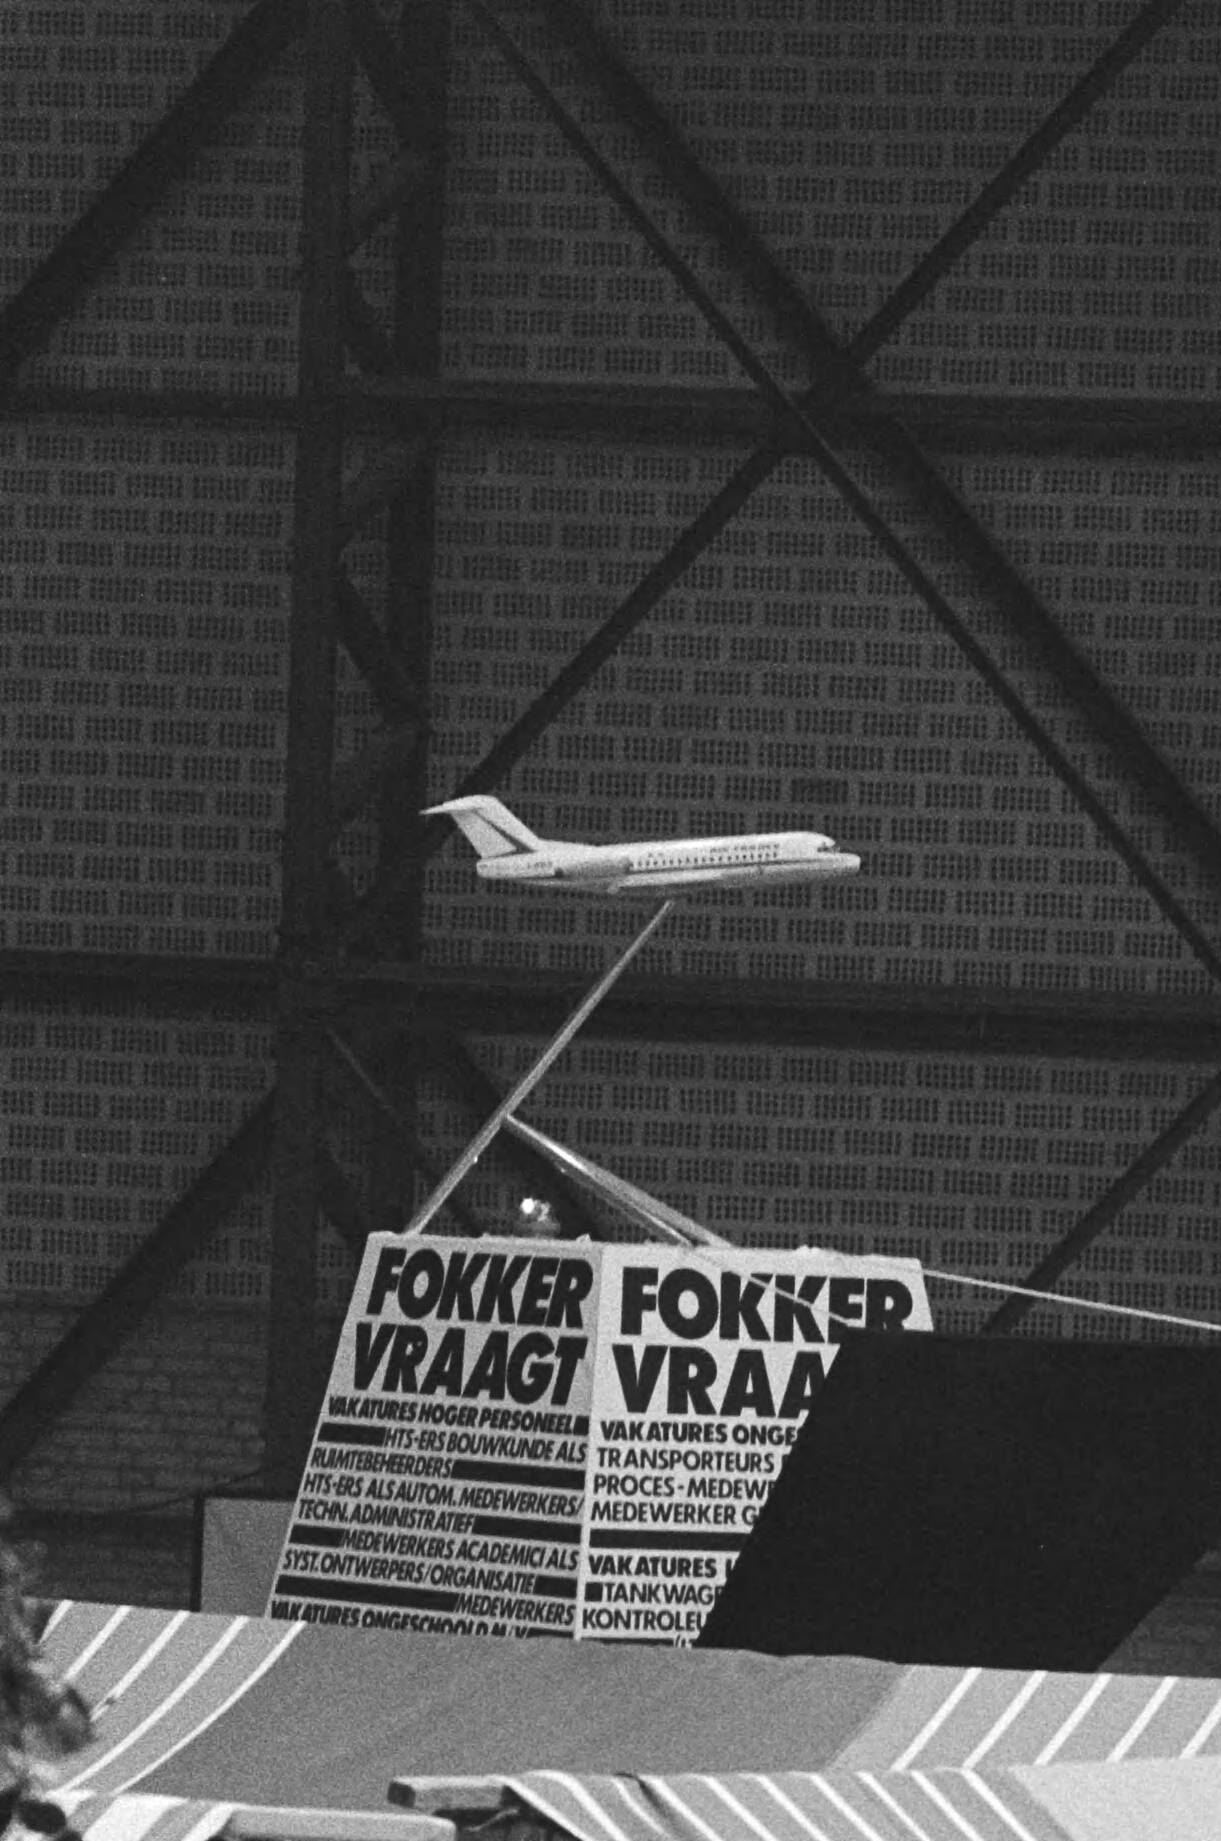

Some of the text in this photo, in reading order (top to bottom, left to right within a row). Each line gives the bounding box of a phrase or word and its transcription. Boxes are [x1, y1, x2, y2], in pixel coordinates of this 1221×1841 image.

[366, 1246, 593, 1329] FOKKER
[620, 1266, 913, 1343] FOKKER
[354, 1321, 588, 1406] VRAAGT
[329, 1396, 574, 1433] VAKATURES HOGER PERSONEEL
[385, 1427, 587, 1464] HTS-ERS BOUWKUNDE ALS
[600, 1420, 728, 1444] VAKATURES
[310, 1447, 453, 1479] RUIMTEBEHEERDERS
[597, 1447, 775, 1473] TRANSPORTEURS
[303, 1473, 363, 1498] HTS-ERS
[365, 1478, 398, 1501] ALS
[298, 1498, 474, 1534] TECHN. ADMINISTRATIEF
[591, 1501, 736, 1526] MEDEWERKER
[343, 1528, 579, 1572] MEDEWERKERS ACADEMICI ALS
[588, 1555, 717, 1578] VAKATURES
[456, 1593, 577, 1626] MEDEWERKERS
